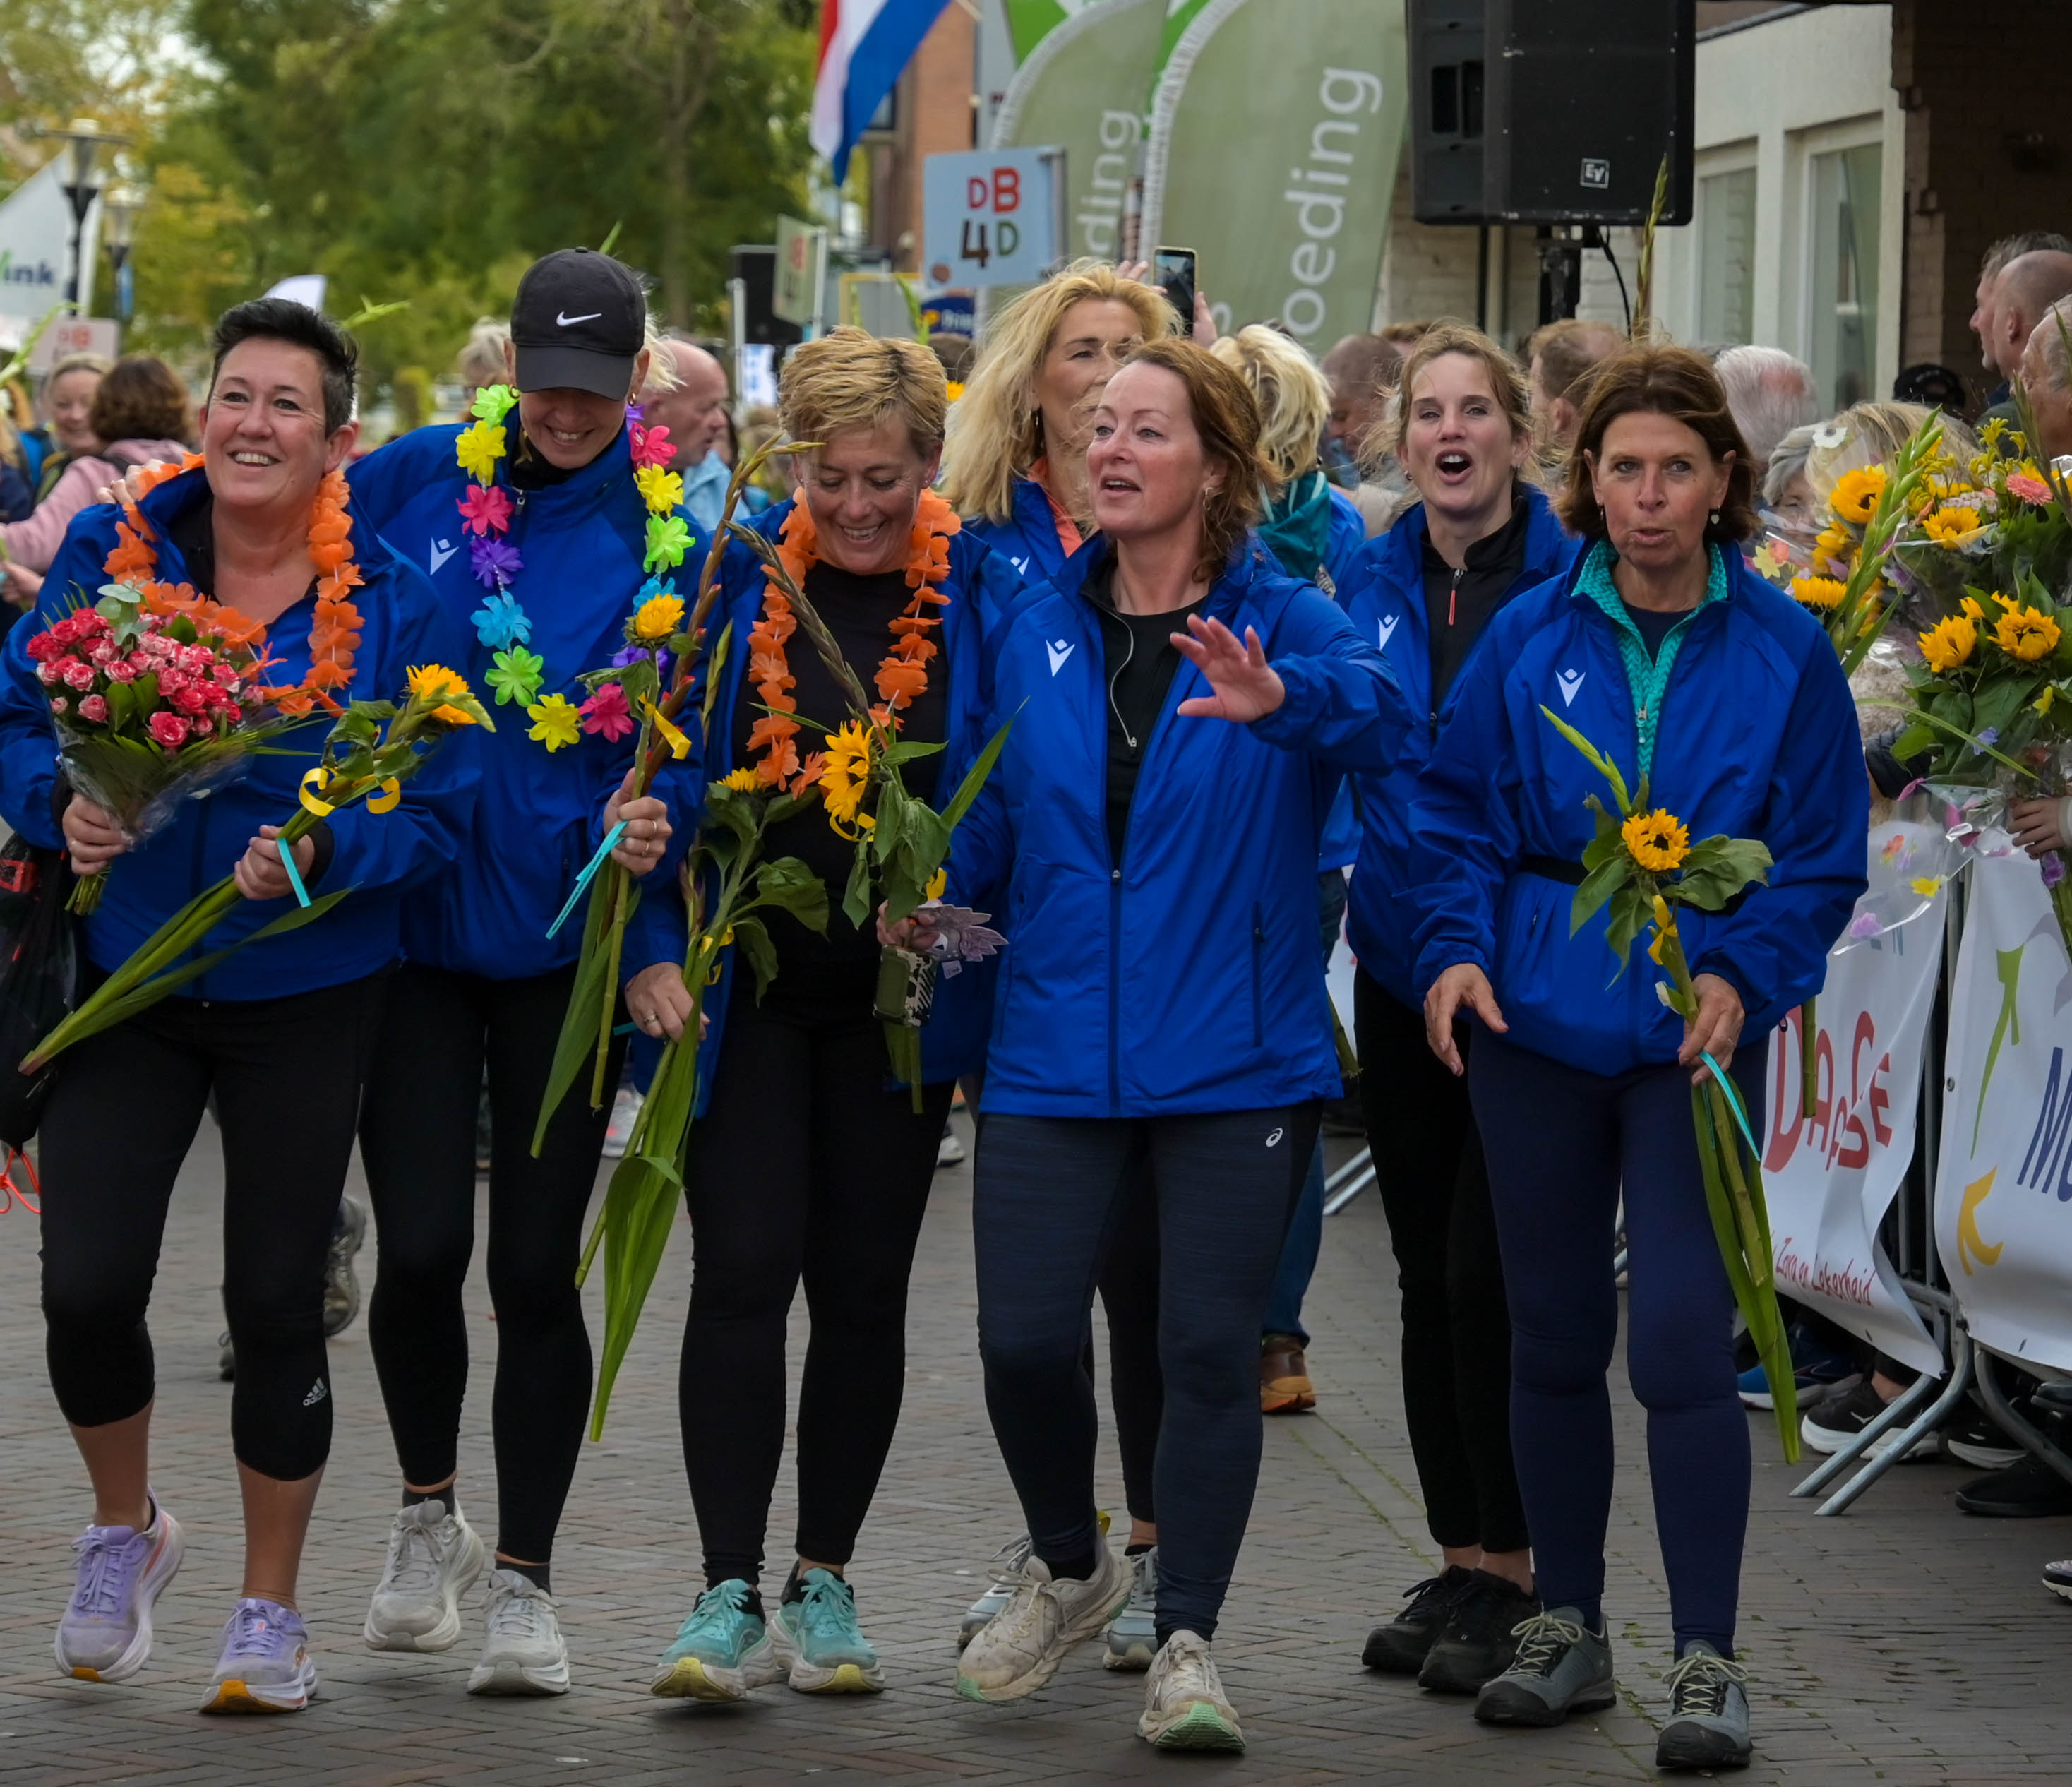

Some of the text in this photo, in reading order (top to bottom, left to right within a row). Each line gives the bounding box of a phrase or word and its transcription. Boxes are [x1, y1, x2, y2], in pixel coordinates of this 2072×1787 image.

[968, 166, 1020, 215] DB
[1077, 109, 1142, 257] ding
[961, 219, 1019, 269] 4D
